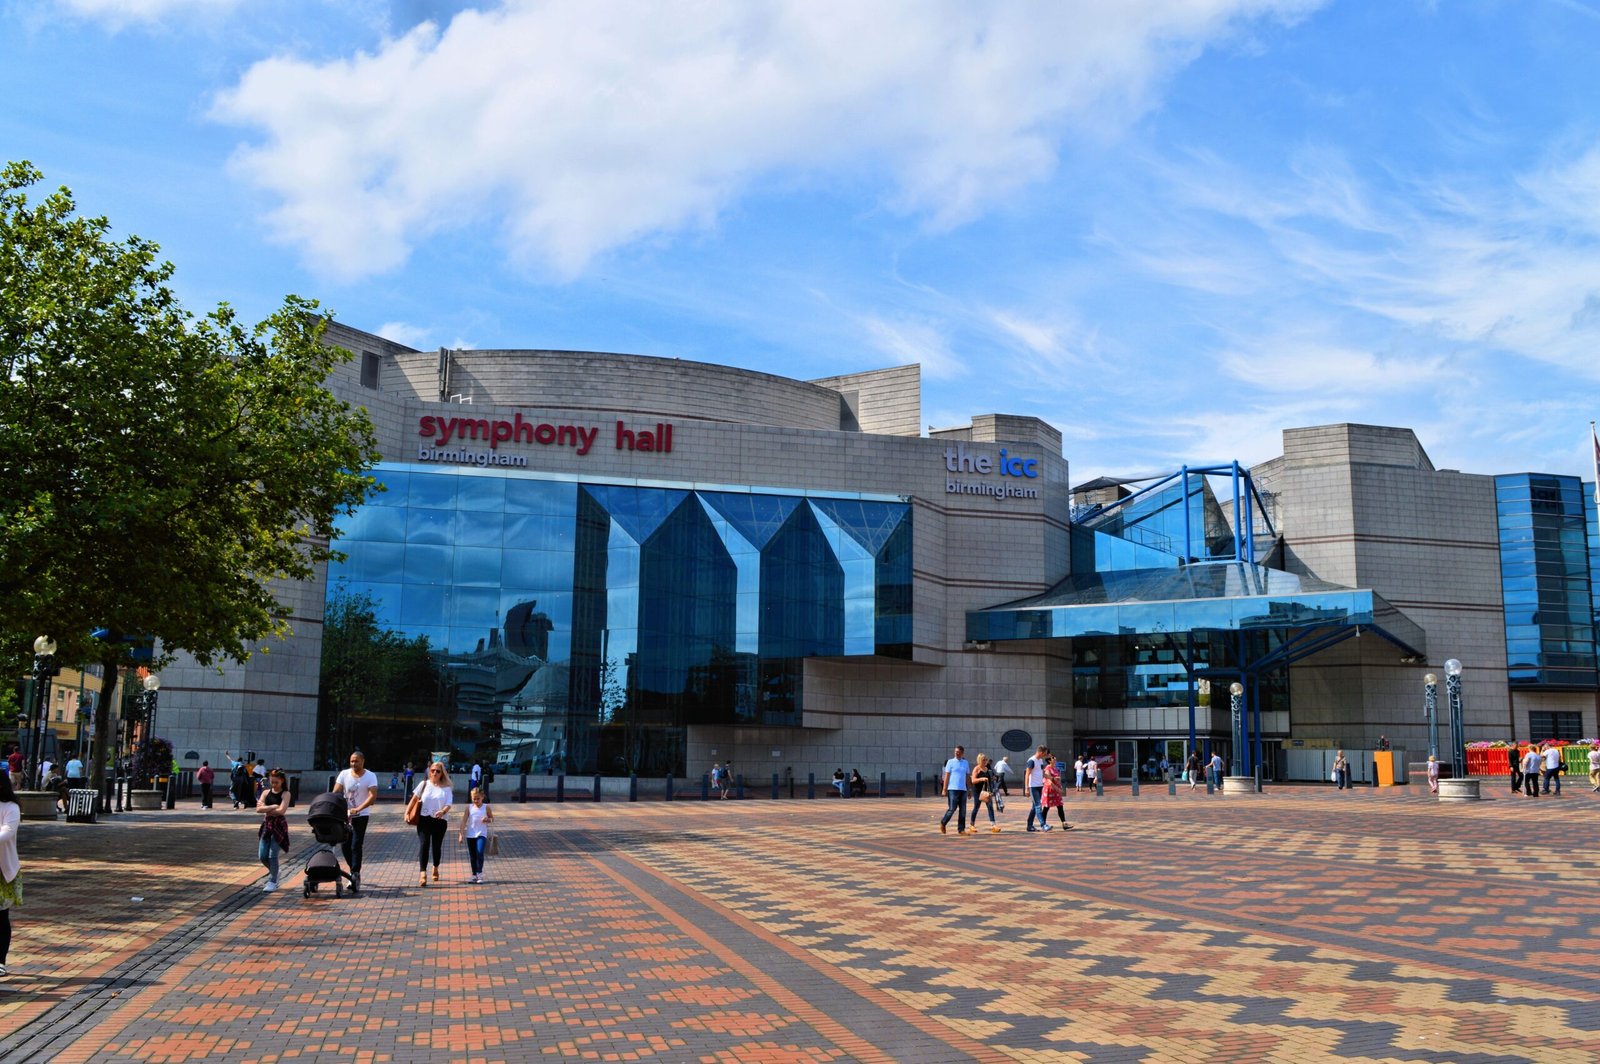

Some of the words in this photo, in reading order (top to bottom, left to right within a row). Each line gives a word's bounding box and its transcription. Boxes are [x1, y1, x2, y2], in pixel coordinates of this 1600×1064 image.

[418, 413, 599, 455] symphony
[616, 420, 673, 453] hall
[418, 444, 528, 467] birmingham
[943, 445, 992, 474] the
[1000, 448, 1038, 478] icc
[945, 478, 1038, 500] birmingham
